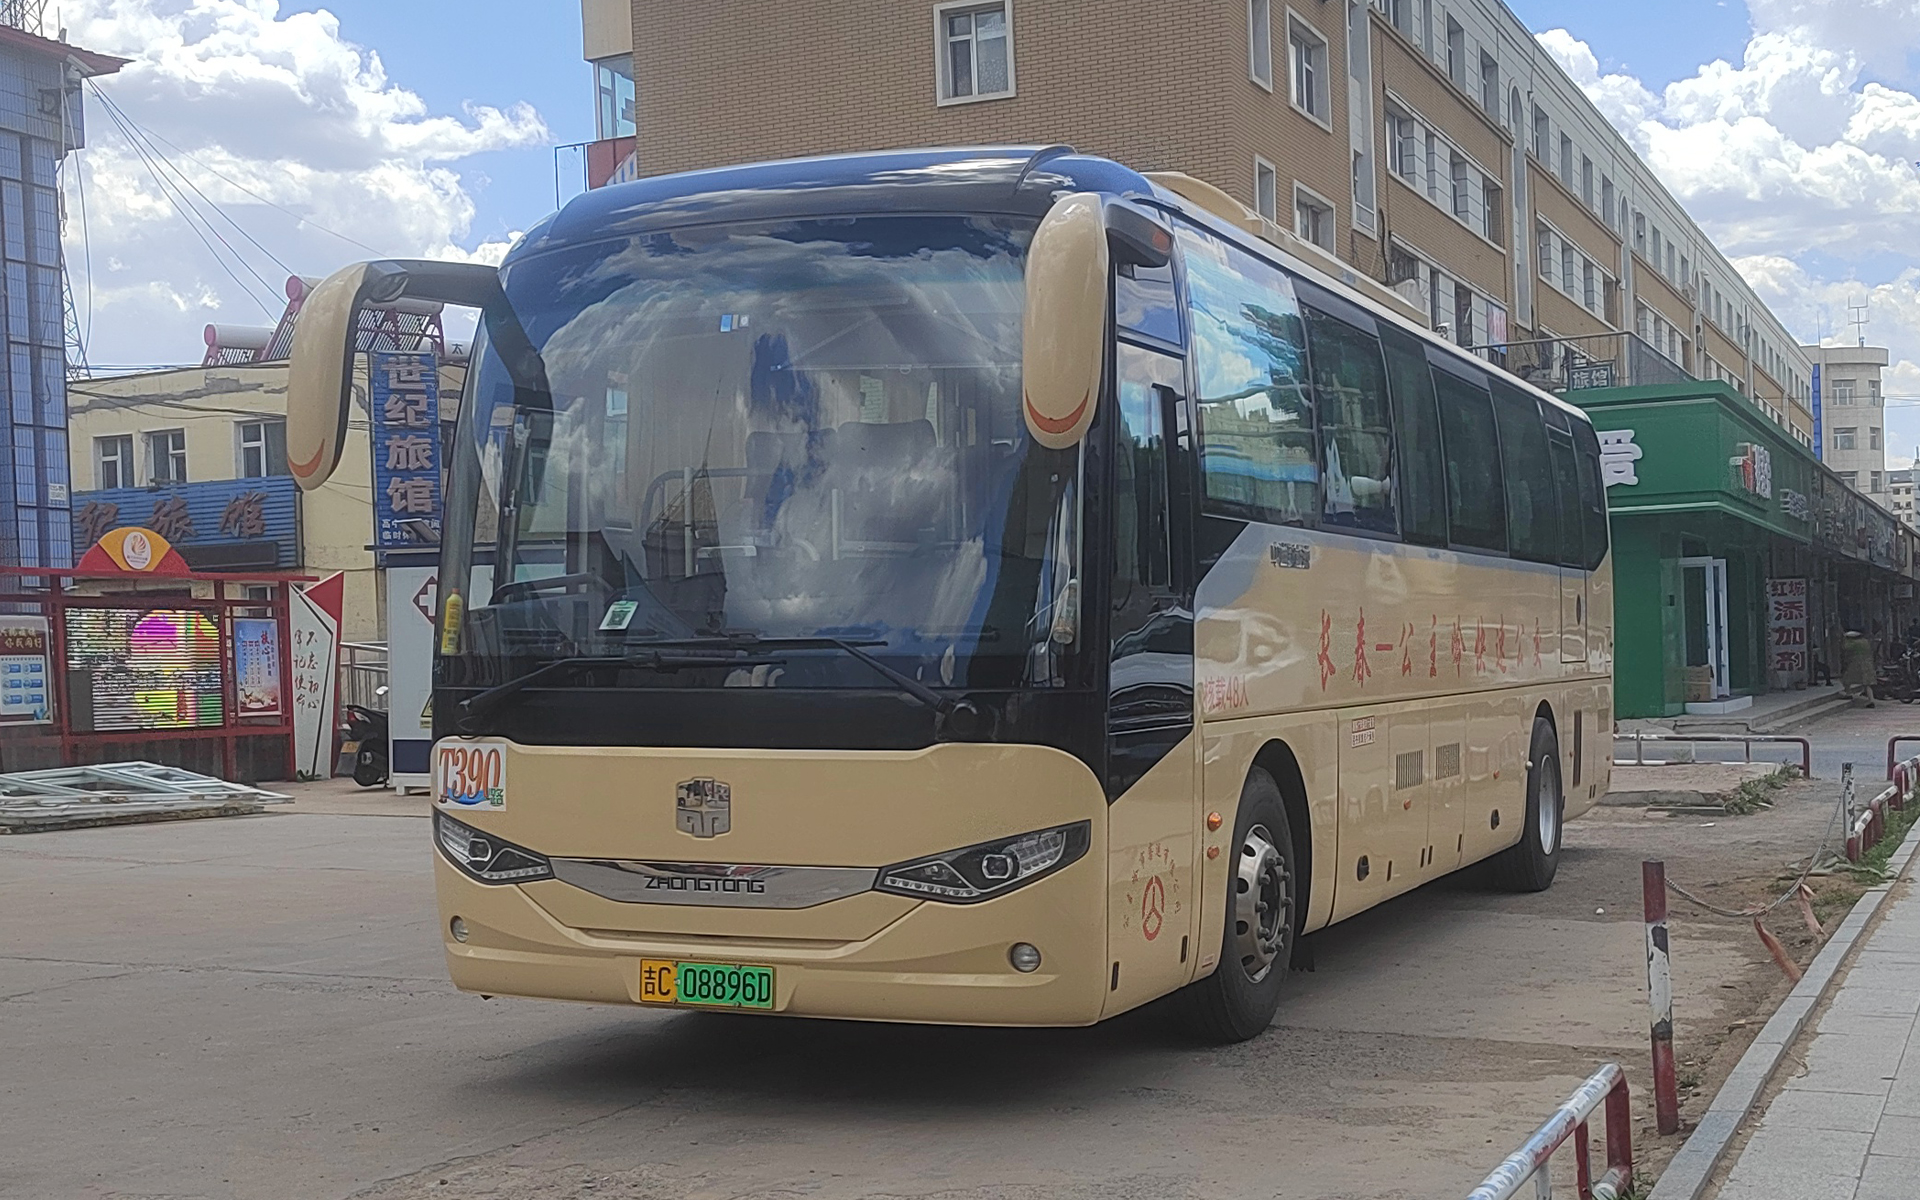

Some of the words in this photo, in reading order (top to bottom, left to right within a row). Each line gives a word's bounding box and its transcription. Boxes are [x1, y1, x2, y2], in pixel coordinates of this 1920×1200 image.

[1572, 370, 1608, 389] 旅馆
[381, 356, 434, 514] 世纪旅馆
[643, 875, 765, 893] ZHONGTONG
